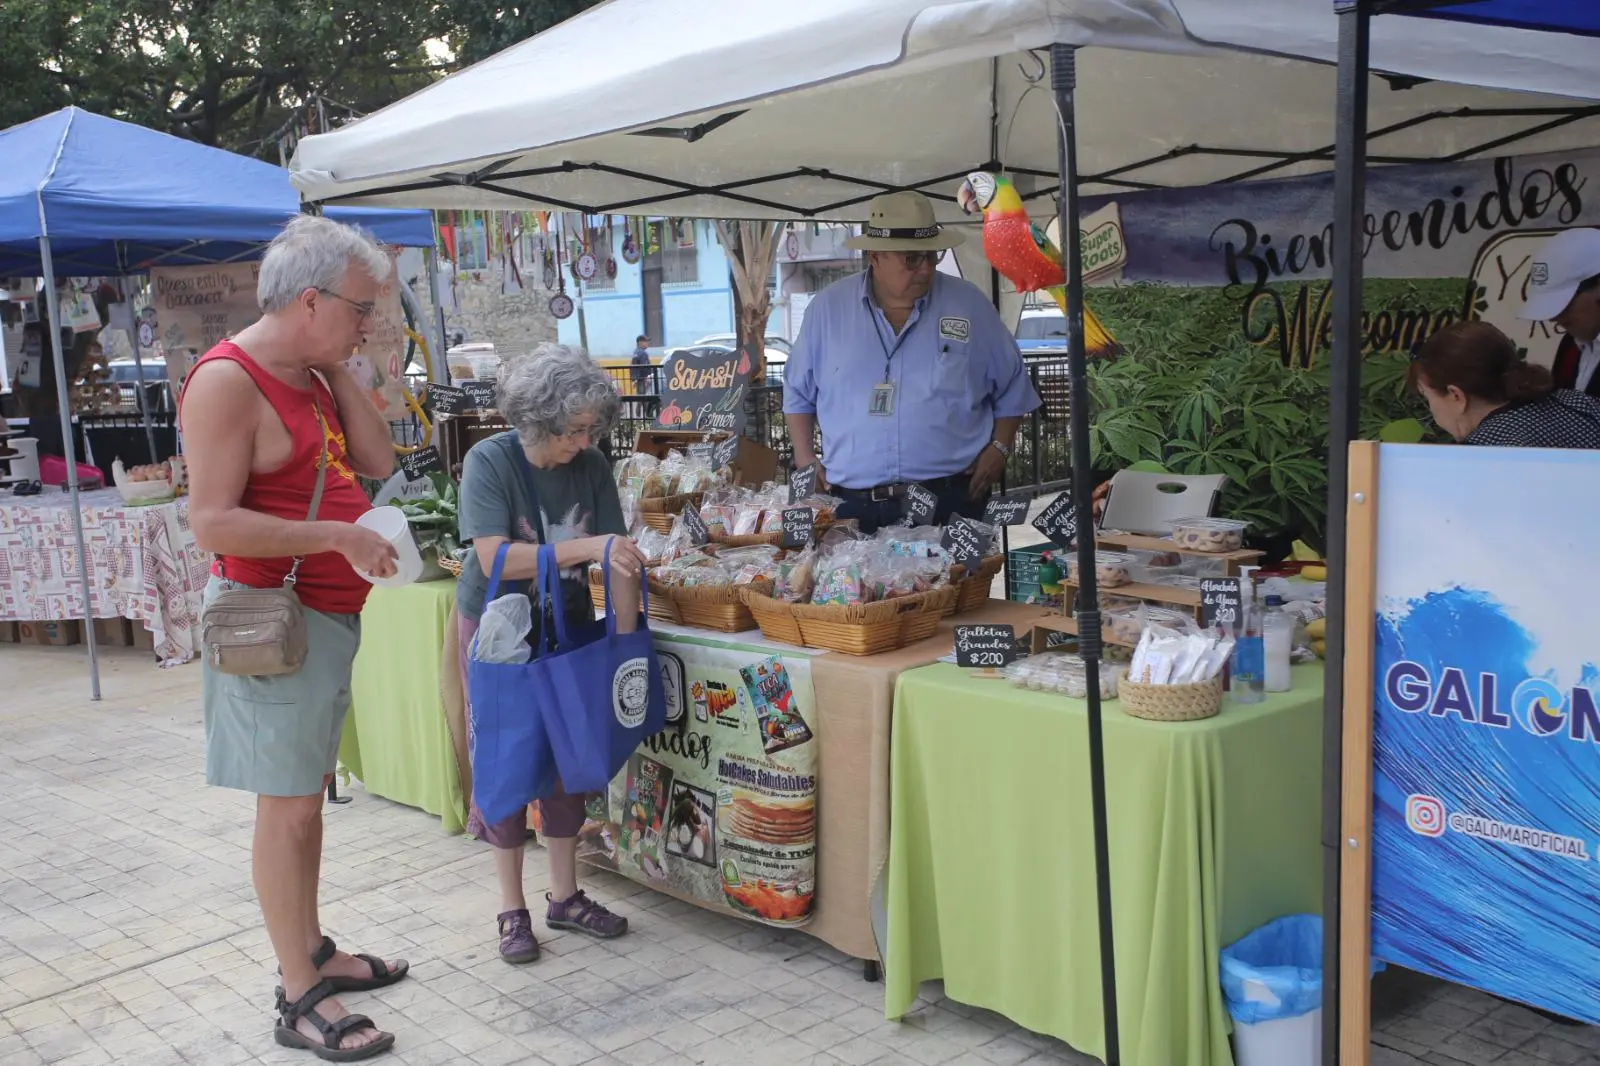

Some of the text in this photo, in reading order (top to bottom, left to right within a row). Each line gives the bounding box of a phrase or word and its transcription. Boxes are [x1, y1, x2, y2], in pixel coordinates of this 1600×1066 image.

[1081, 227, 1113, 254] Super
[166, 291, 224, 310] Oaxaca
[669, 359, 738, 391] SQUASH
[697, 402, 737, 431] Corner
[402, 449, 433, 464] Yuca
[404, 457, 438, 471] Fresca
[784, 510, 810, 520] Chips
[911, 501, 928, 517] $20
[994, 511, 1014, 523] $45
[1034, 497, 1070, 529] Galletas
[793, 532, 809, 541] $25
[955, 520, 979, 544] Taro
[1045, 526, 1056, 536] de
[947, 525, 981, 557] Chips
[949, 542, 969, 562] $75
[1204, 593, 1238, 609] de Yuca
[1215, 607, 1236, 623] $20
[956, 626, 1011, 640] Galletas
[957, 638, 1012, 652] Grandes
[969, 651, 1004, 665] $200
[718, 758, 816, 791] HotCakes Saludables
[1450, 815, 1587, 858] @GALOMAROFICIAL
